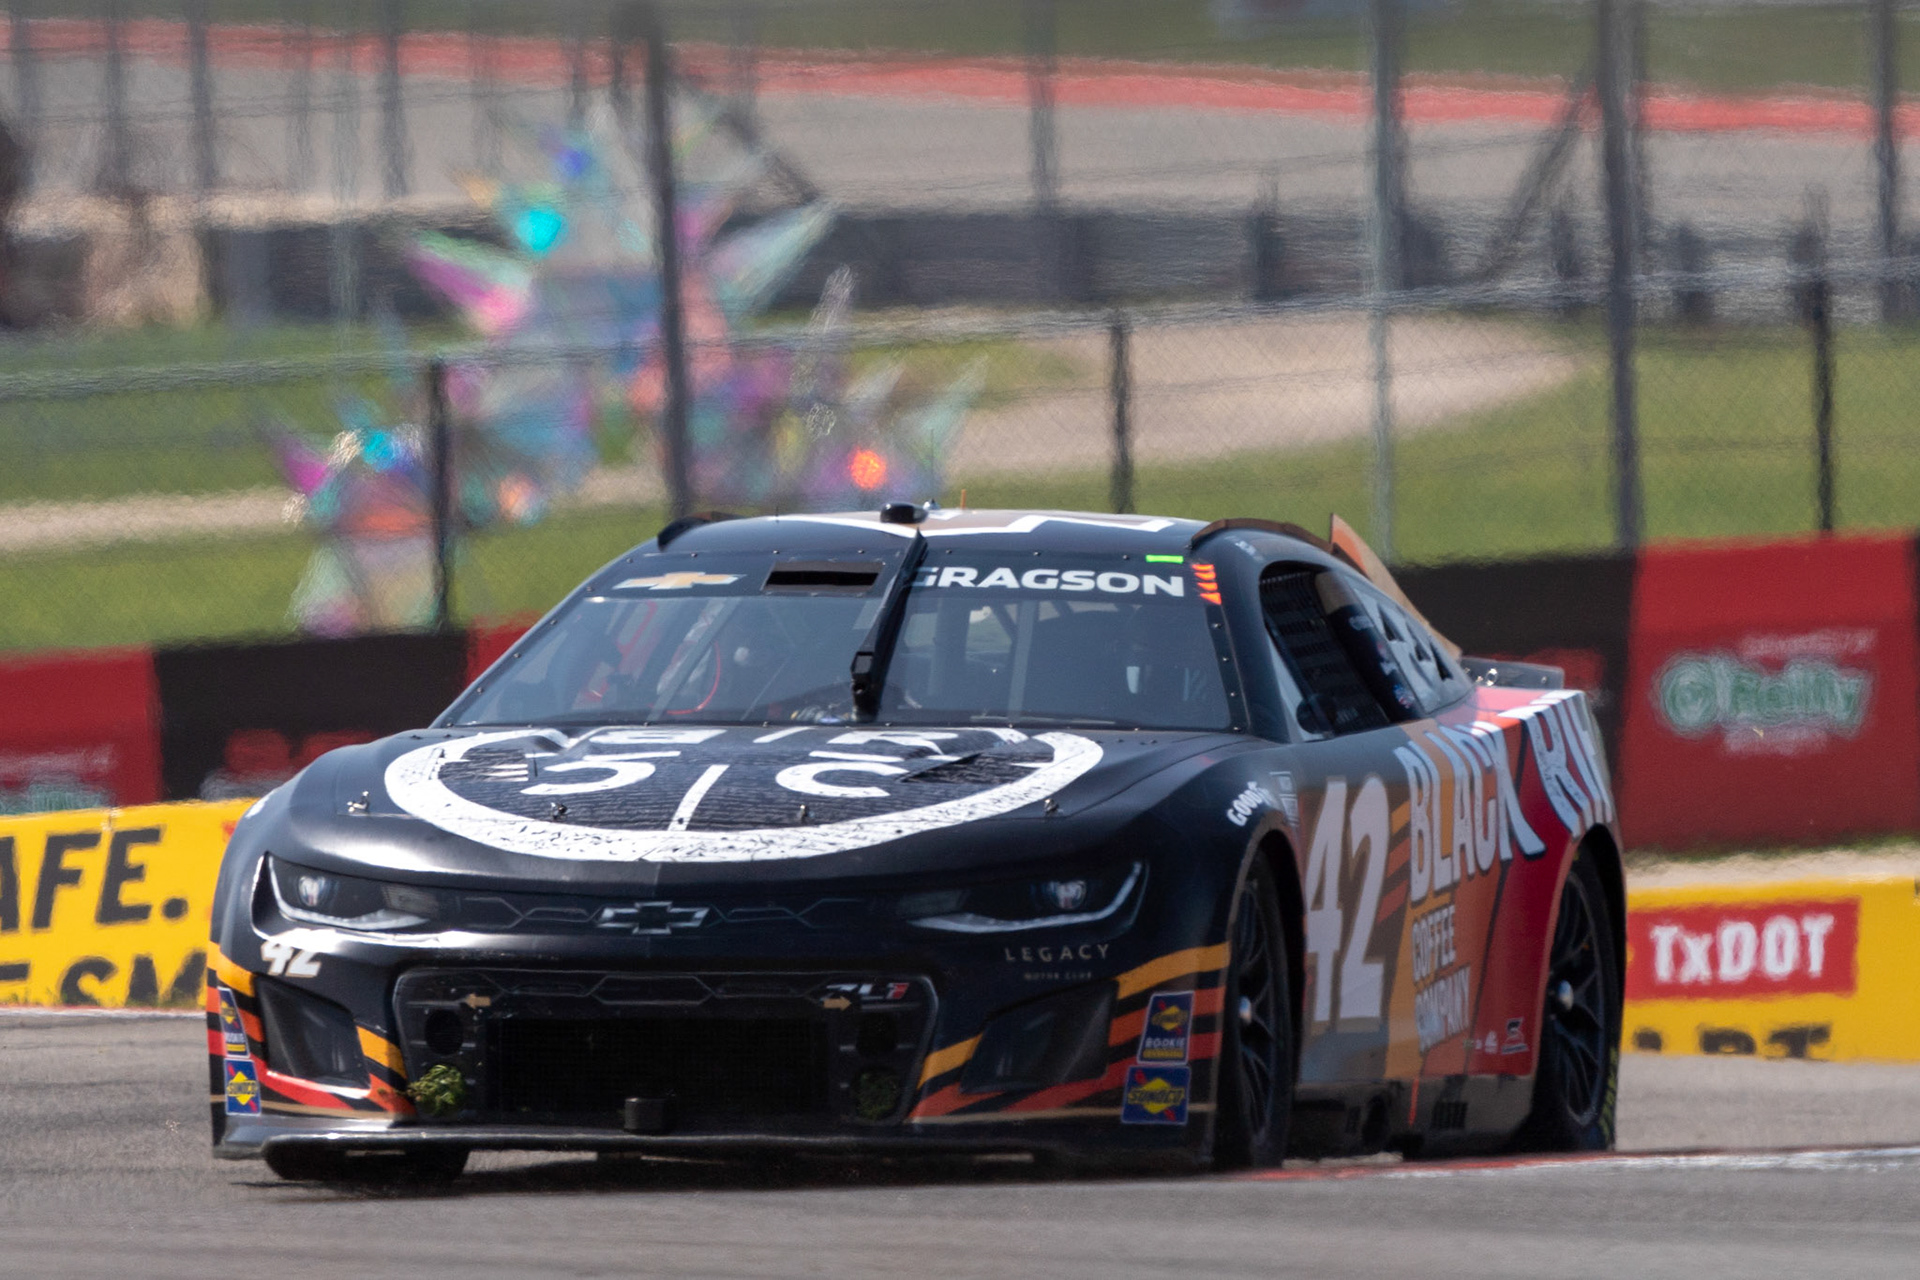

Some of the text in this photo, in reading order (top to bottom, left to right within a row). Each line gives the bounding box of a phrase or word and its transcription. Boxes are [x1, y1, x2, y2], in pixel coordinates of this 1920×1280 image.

[913, 566, 1186, 597] GRAGSON
[1394, 720, 1546, 902] BLACK
[1304, 776, 1390, 1022] 42
[1004, 943, 1110, 962] LEGACY
[1411, 904, 1456, 981] COFFEE
[1650, 914, 1835, 984] TxDOT
[1144, 1037, 1186, 1049] ROOKIE
[1415, 967, 1471, 1054] COMPANY
